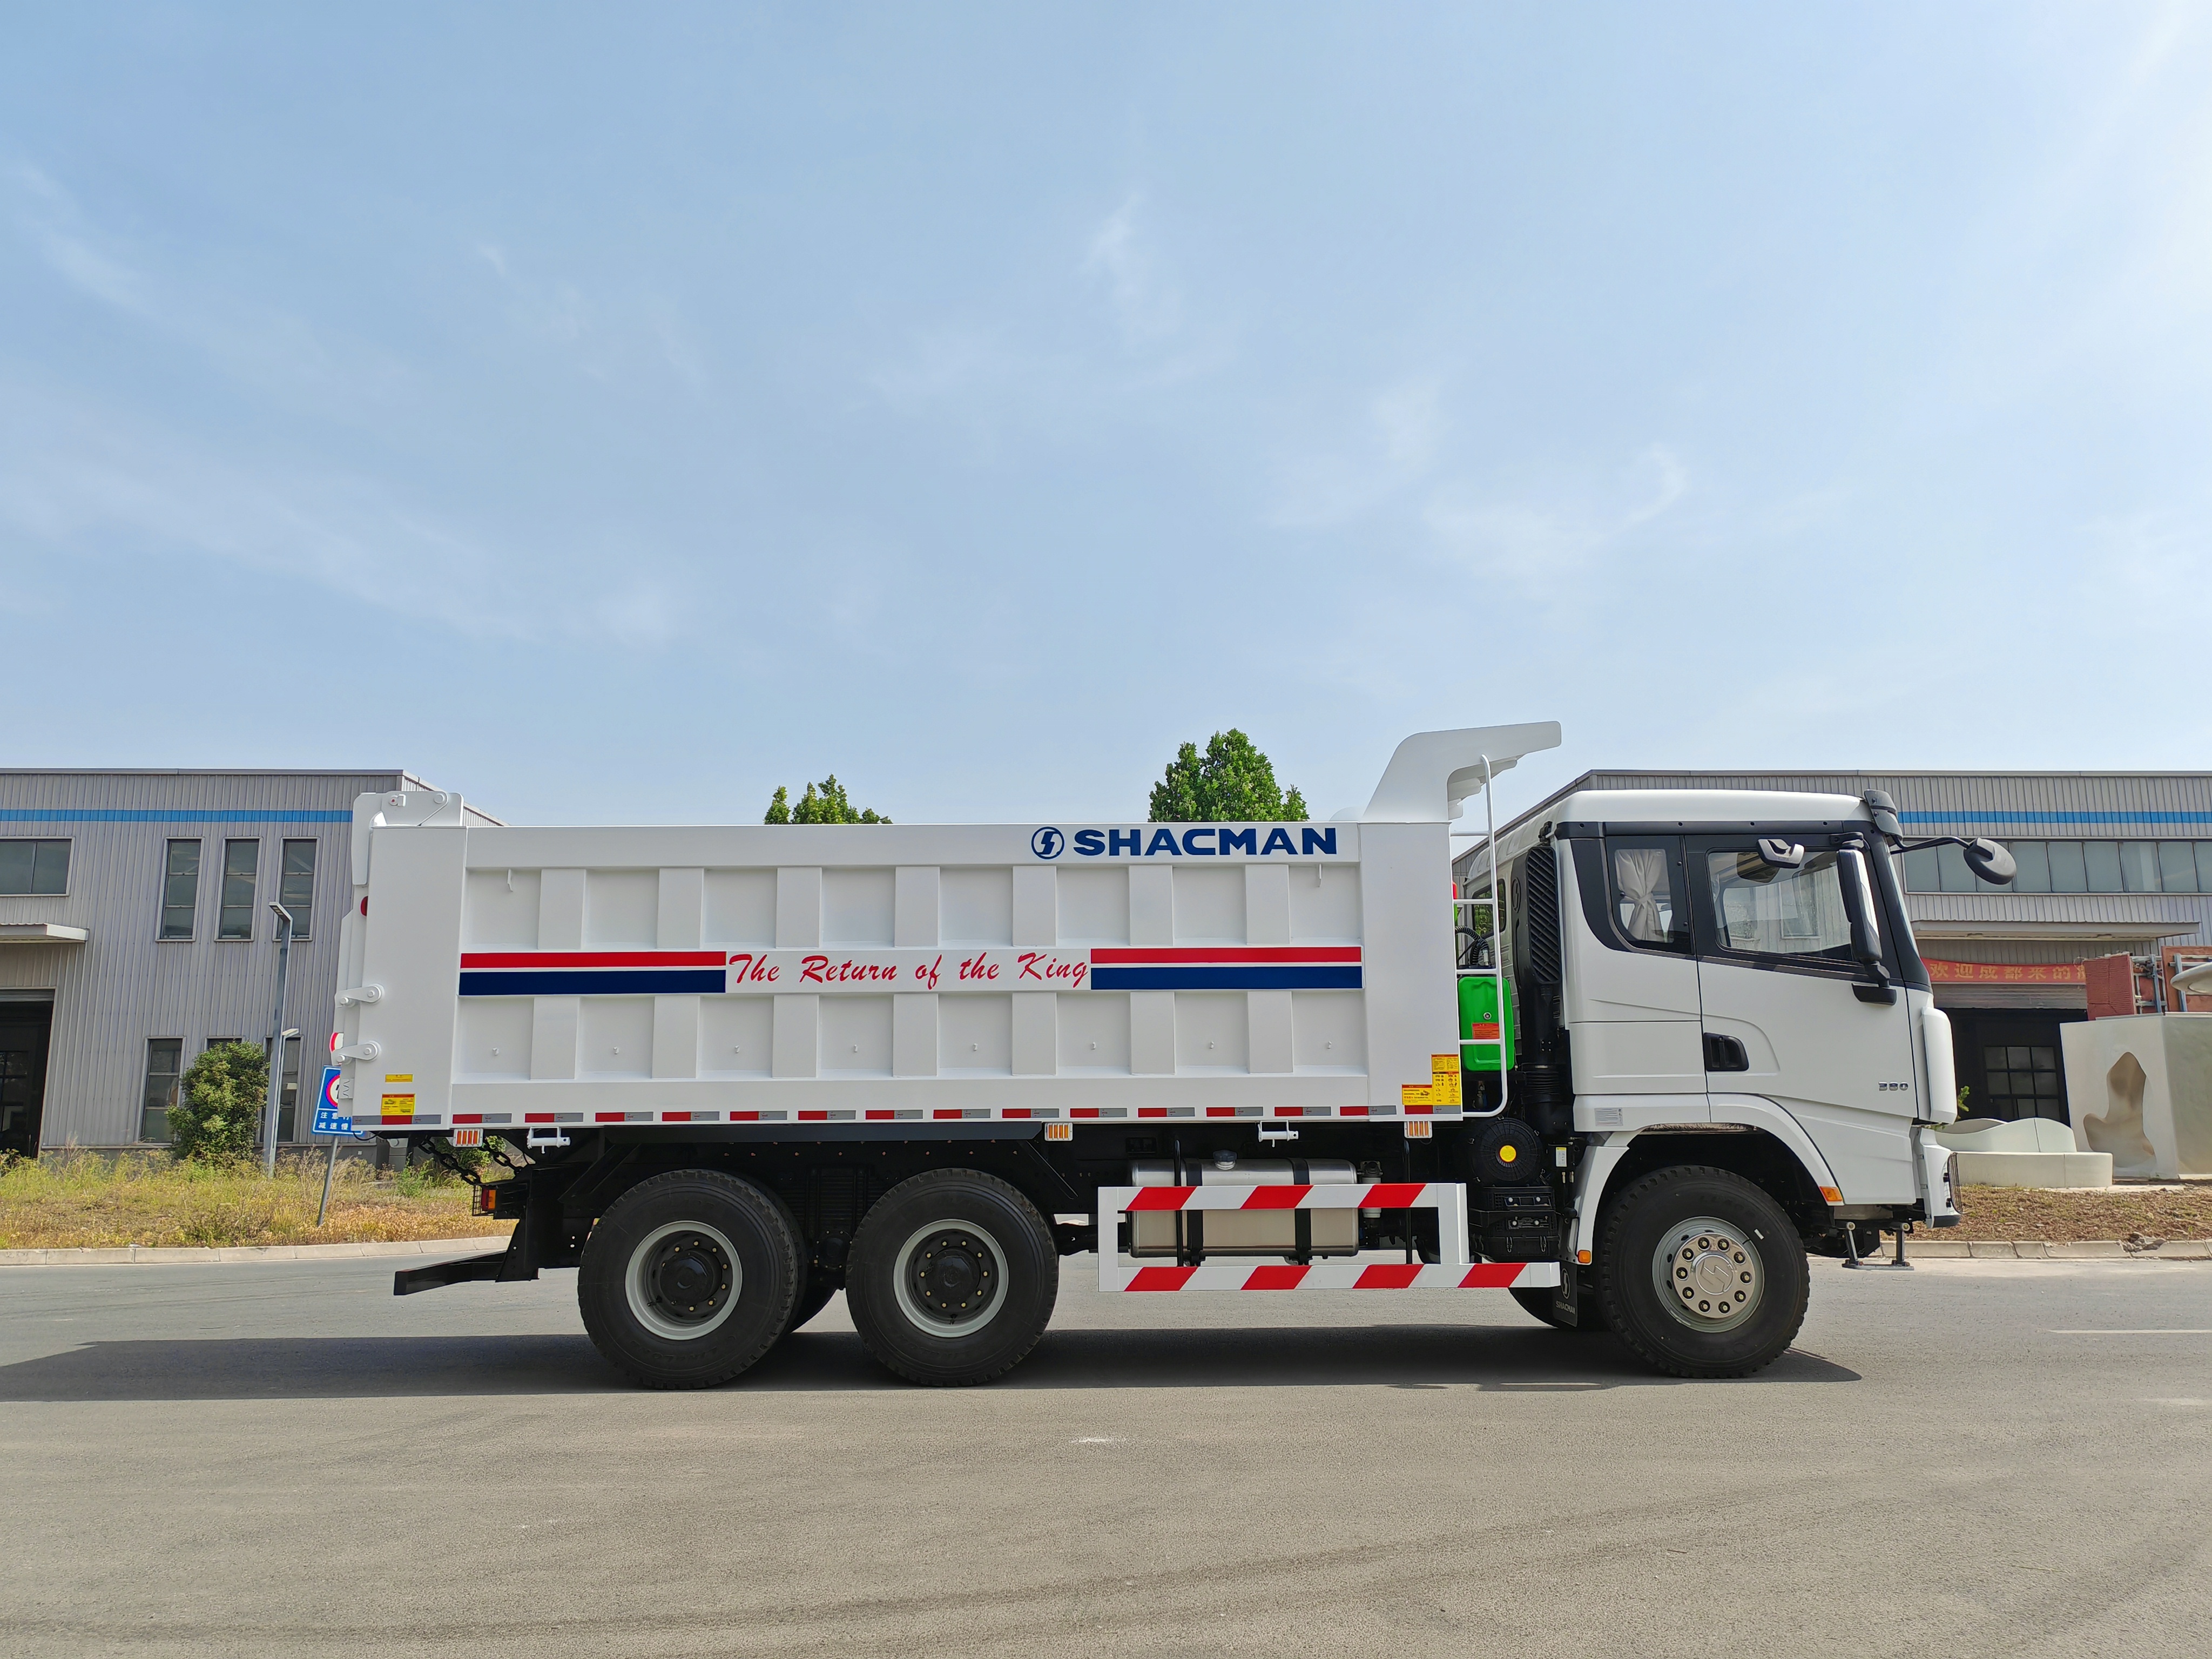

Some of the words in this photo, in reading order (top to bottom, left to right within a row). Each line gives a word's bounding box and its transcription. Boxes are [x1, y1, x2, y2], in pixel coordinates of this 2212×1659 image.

[1074, 828, 1337, 856] SHACMAN
[729, 954, 779, 983] The
[800, 955, 896, 983] Return
[916, 956, 941, 989] of
[959, 952, 999, 980] the
[1017, 953, 1088, 988] King
[1878, 1081, 1908, 1091] 380
[320, 1112, 349, 1120] 注意
